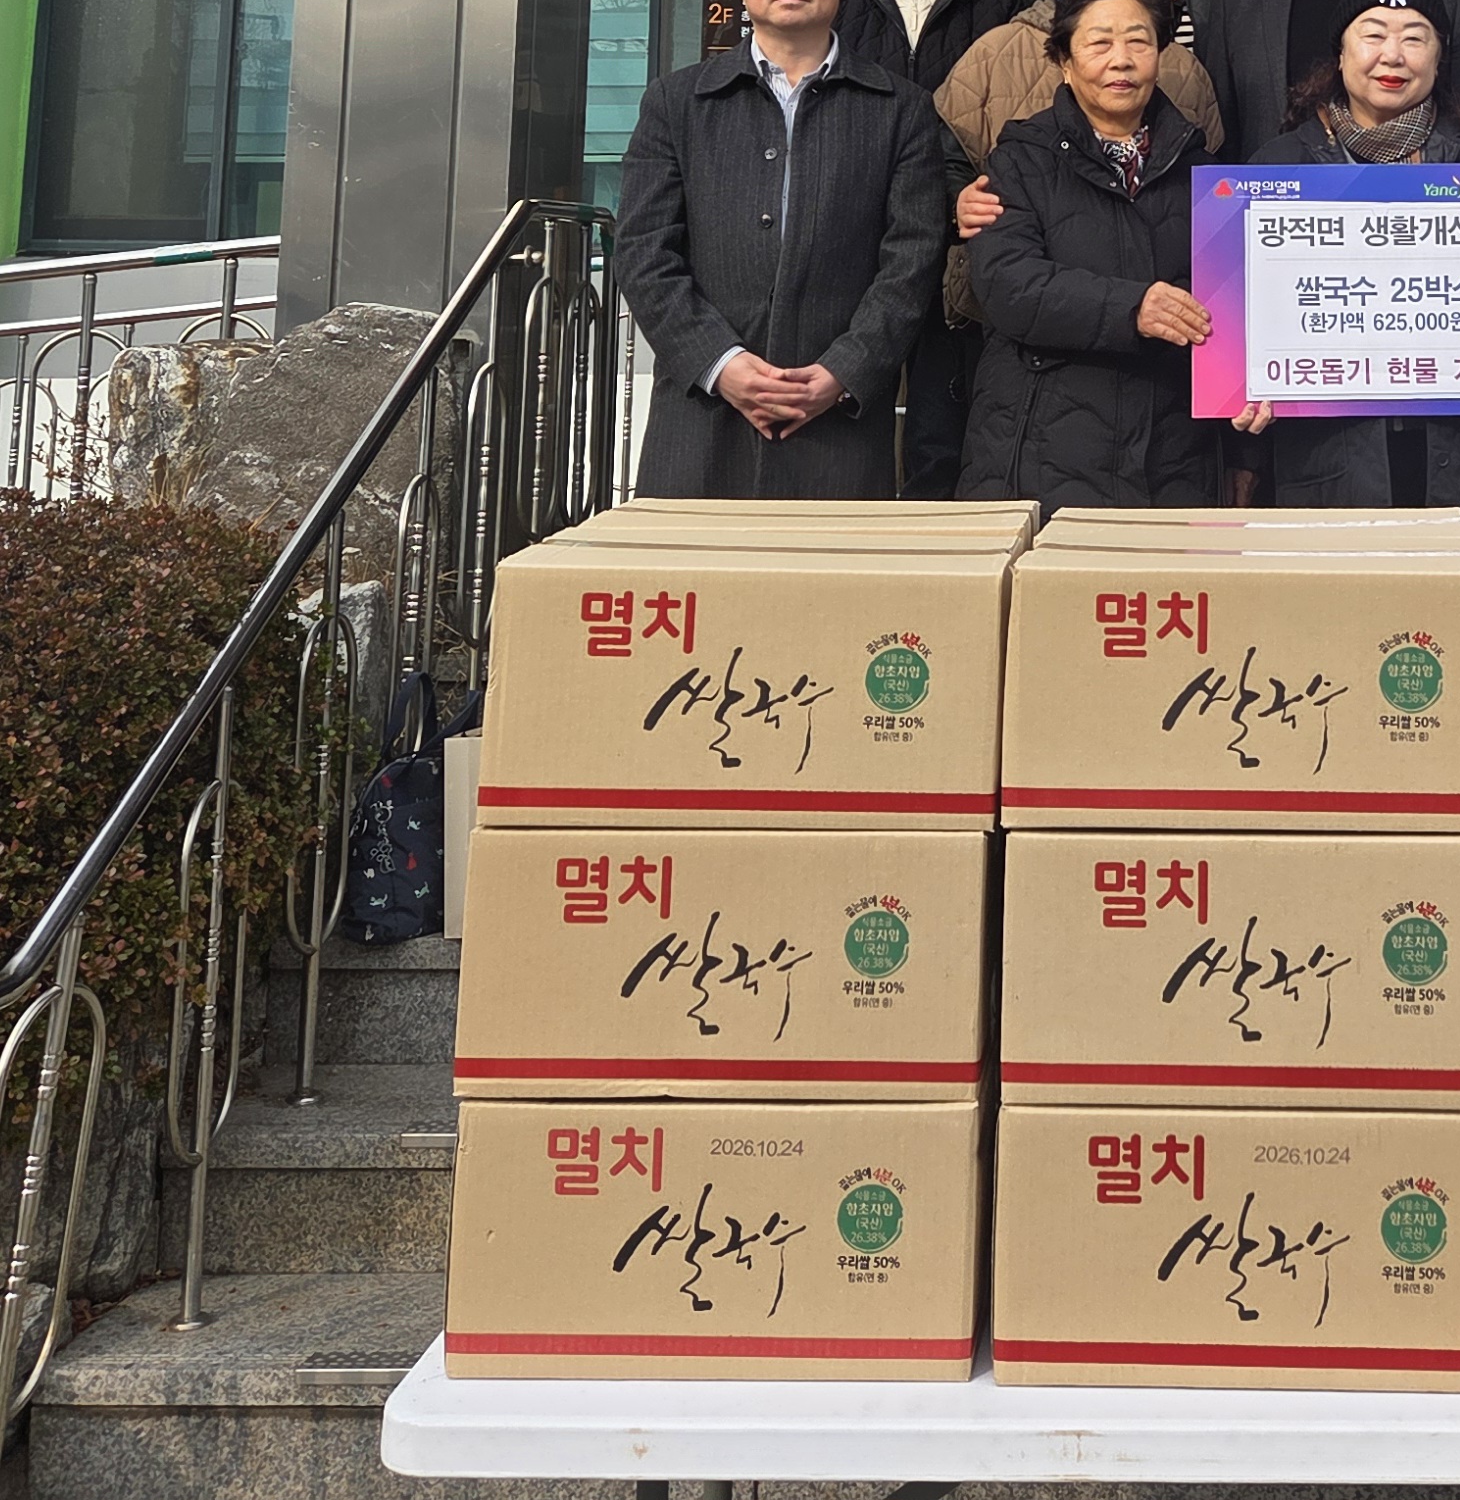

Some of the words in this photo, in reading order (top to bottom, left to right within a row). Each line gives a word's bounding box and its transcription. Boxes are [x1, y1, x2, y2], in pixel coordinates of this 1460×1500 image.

[708, 3, 734, 24] 2F
[1258, 216, 1344, 247] 광적면
[1295, 276, 1378, 306] 쌀국수
[1301, 312, 1365, 334] (환가액
[1267, 358, 1371, 385] 이웃돕기
[1387, 357, 1438, 385] 현물
[581, 591, 697, 657] 멸치
[1096, 592, 1209, 658] 멸치
[644, 647, 833, 772] 쌀국수
[863, 716, 896, 730] 우리쌀
[899, 716, 924, 729] 50%
[1162, 647, 1348, 773] 쌀국수
[1378, 715, 1412, 730] 우리쌀
[1414, 716, 1440, 728] 50%
[556, 856, 673, 924] 멸치
[1095, 860, 1208, 928] 멸치
[621, 912, 812, 1040] 쌀국수
[842, 981, 876, 996] 우리쌀
[879, 982, 904, 994] 50%
[1163, 917, 1351, 1047] 쌀국수
[1382, 988, 1416, 1003] 우리쌀
[1419, 989, 1445, 1002] 50%
[548, 1127, 663, 1196] 멸치
[710, 1139, 804, 1157] 2026.10.24
[1254, 1146, 1350, 1165] 2026.10.24
[1089, 1134, 1204, 1204] 멸치
[613, 1184, 806, 1316] 쌀국수
[836, 1256, 870, 1271] 우리쌀
[873, 1256, 899, 1269] 50%
[1158, 1193, 1349, 1326] 쌀국수
[1381, 1266, 1416, 1281] 우리쌀
[1418, 1267, 1445, 1280] 50%
